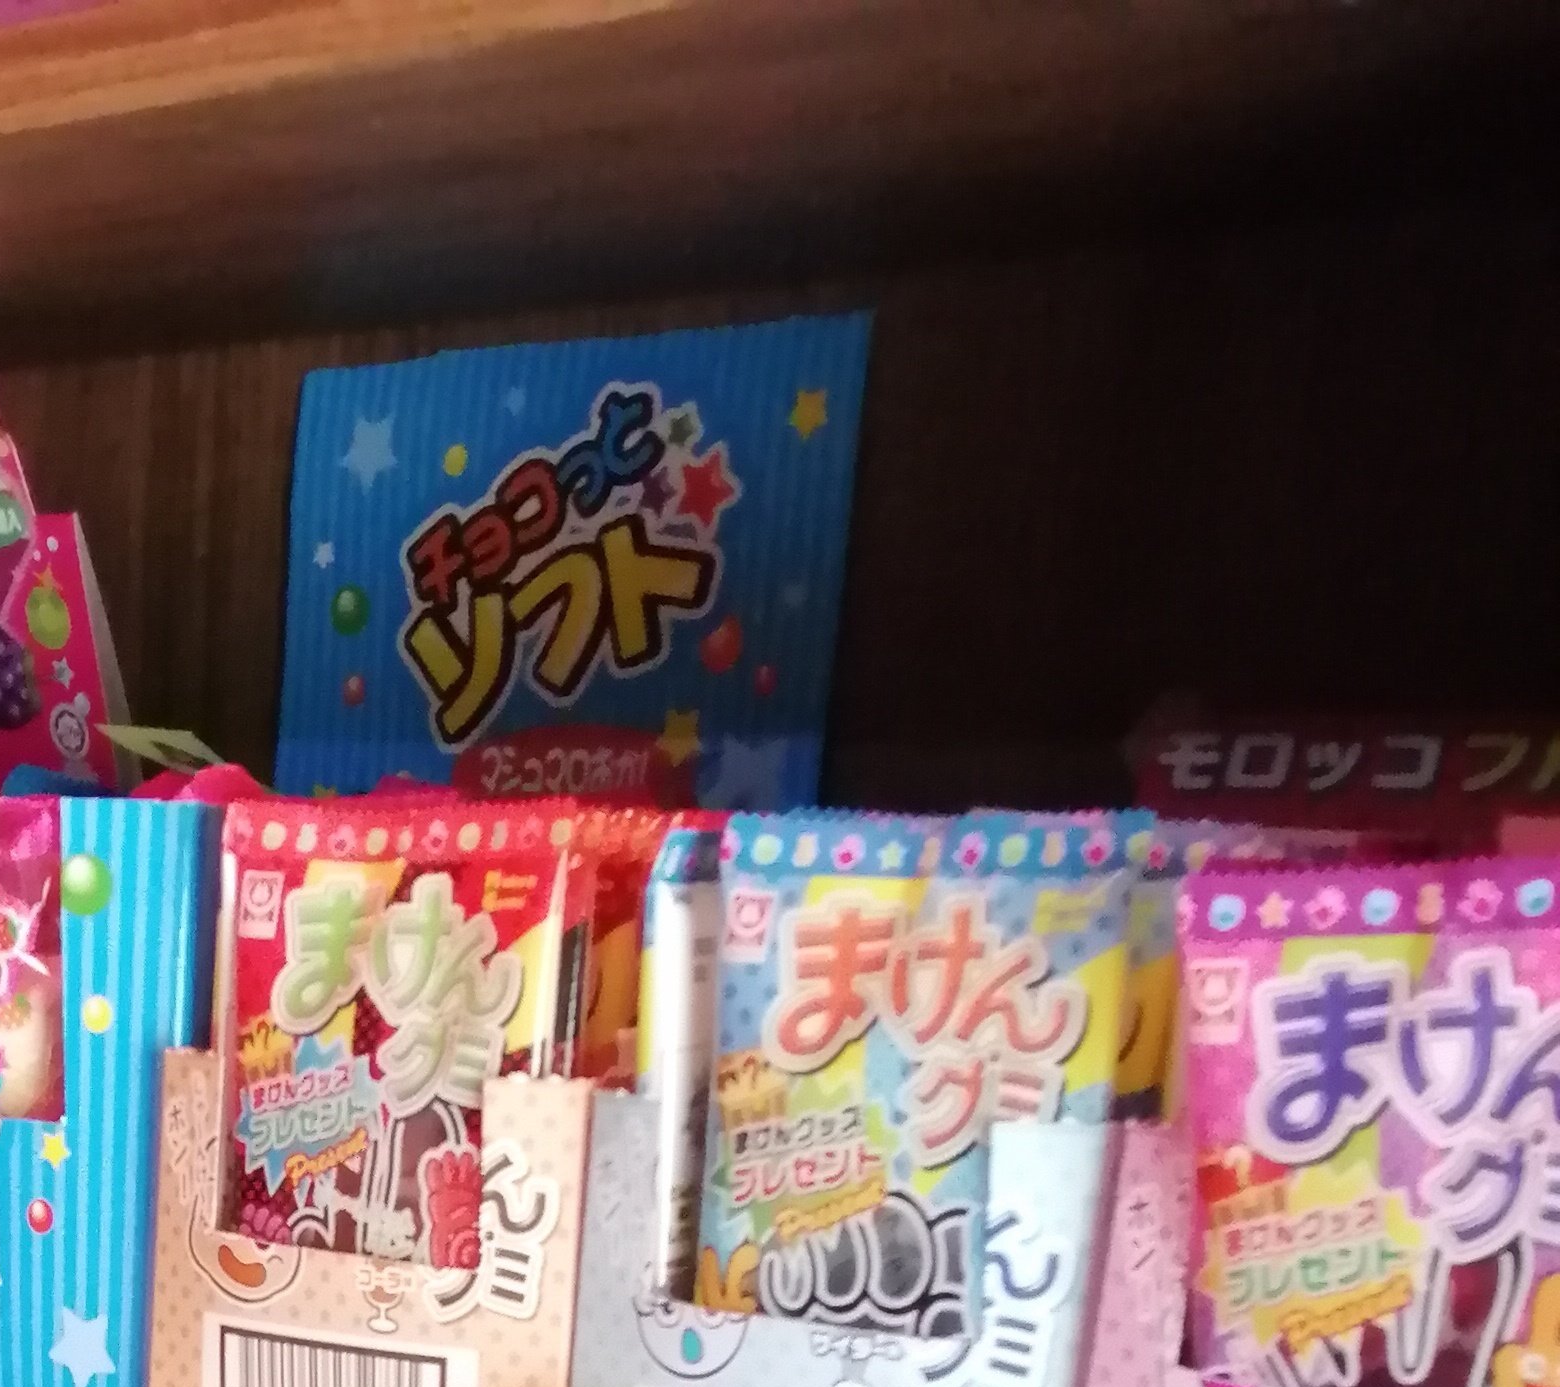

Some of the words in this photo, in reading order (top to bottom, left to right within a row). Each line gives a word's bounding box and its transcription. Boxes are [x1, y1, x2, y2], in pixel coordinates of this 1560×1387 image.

[409, 389, 662, 606] チョコっと
[406, 512, 715, 742] ソフト
[1160, 735, 1560, 792] モロッコフ
[277, 878, 517, 1031] まけん
[778, 913, 1072, 1058] まけん
[731, 1146, 883, 1202] プレゼント
[1226, 1244, 1406, 1310] プレゼント
